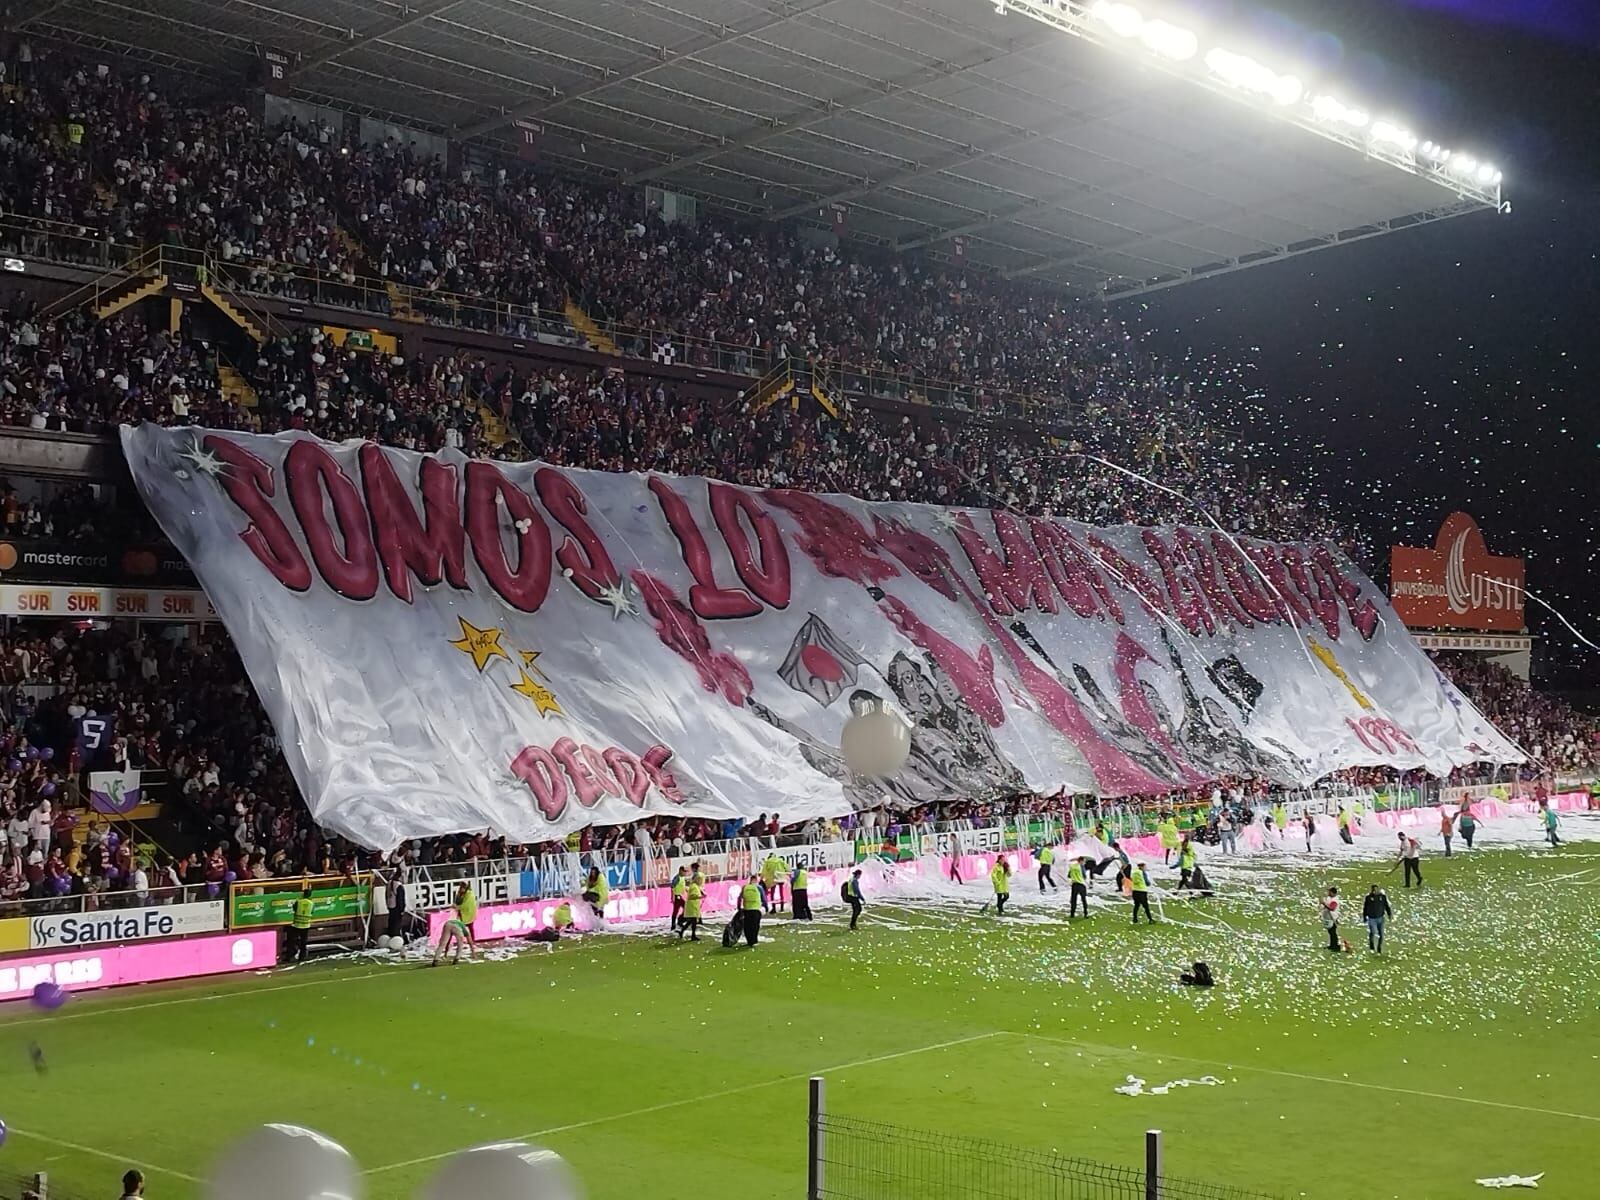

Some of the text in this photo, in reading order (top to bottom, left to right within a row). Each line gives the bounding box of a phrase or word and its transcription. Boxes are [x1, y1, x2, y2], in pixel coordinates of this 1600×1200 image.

[271, 65, 284, 79] 16
[524, 131, 534, 144] 11
[202, 434, 620, 614] SOMOS
[647, 475, 792, 620] LO
[23, 552, 108, 568] mastercard
[1393, 581, 1446, 598] UNIVERSIDAD
[18, 594, 50, 611] SUR
[67, 595, 99, 611] SUR
[116, 596, 147, 613] SUR
[163, 597, 193, 613] SUR
[60, 914, 141, 944] Santa
[144, 911, 173, 935] Fe
